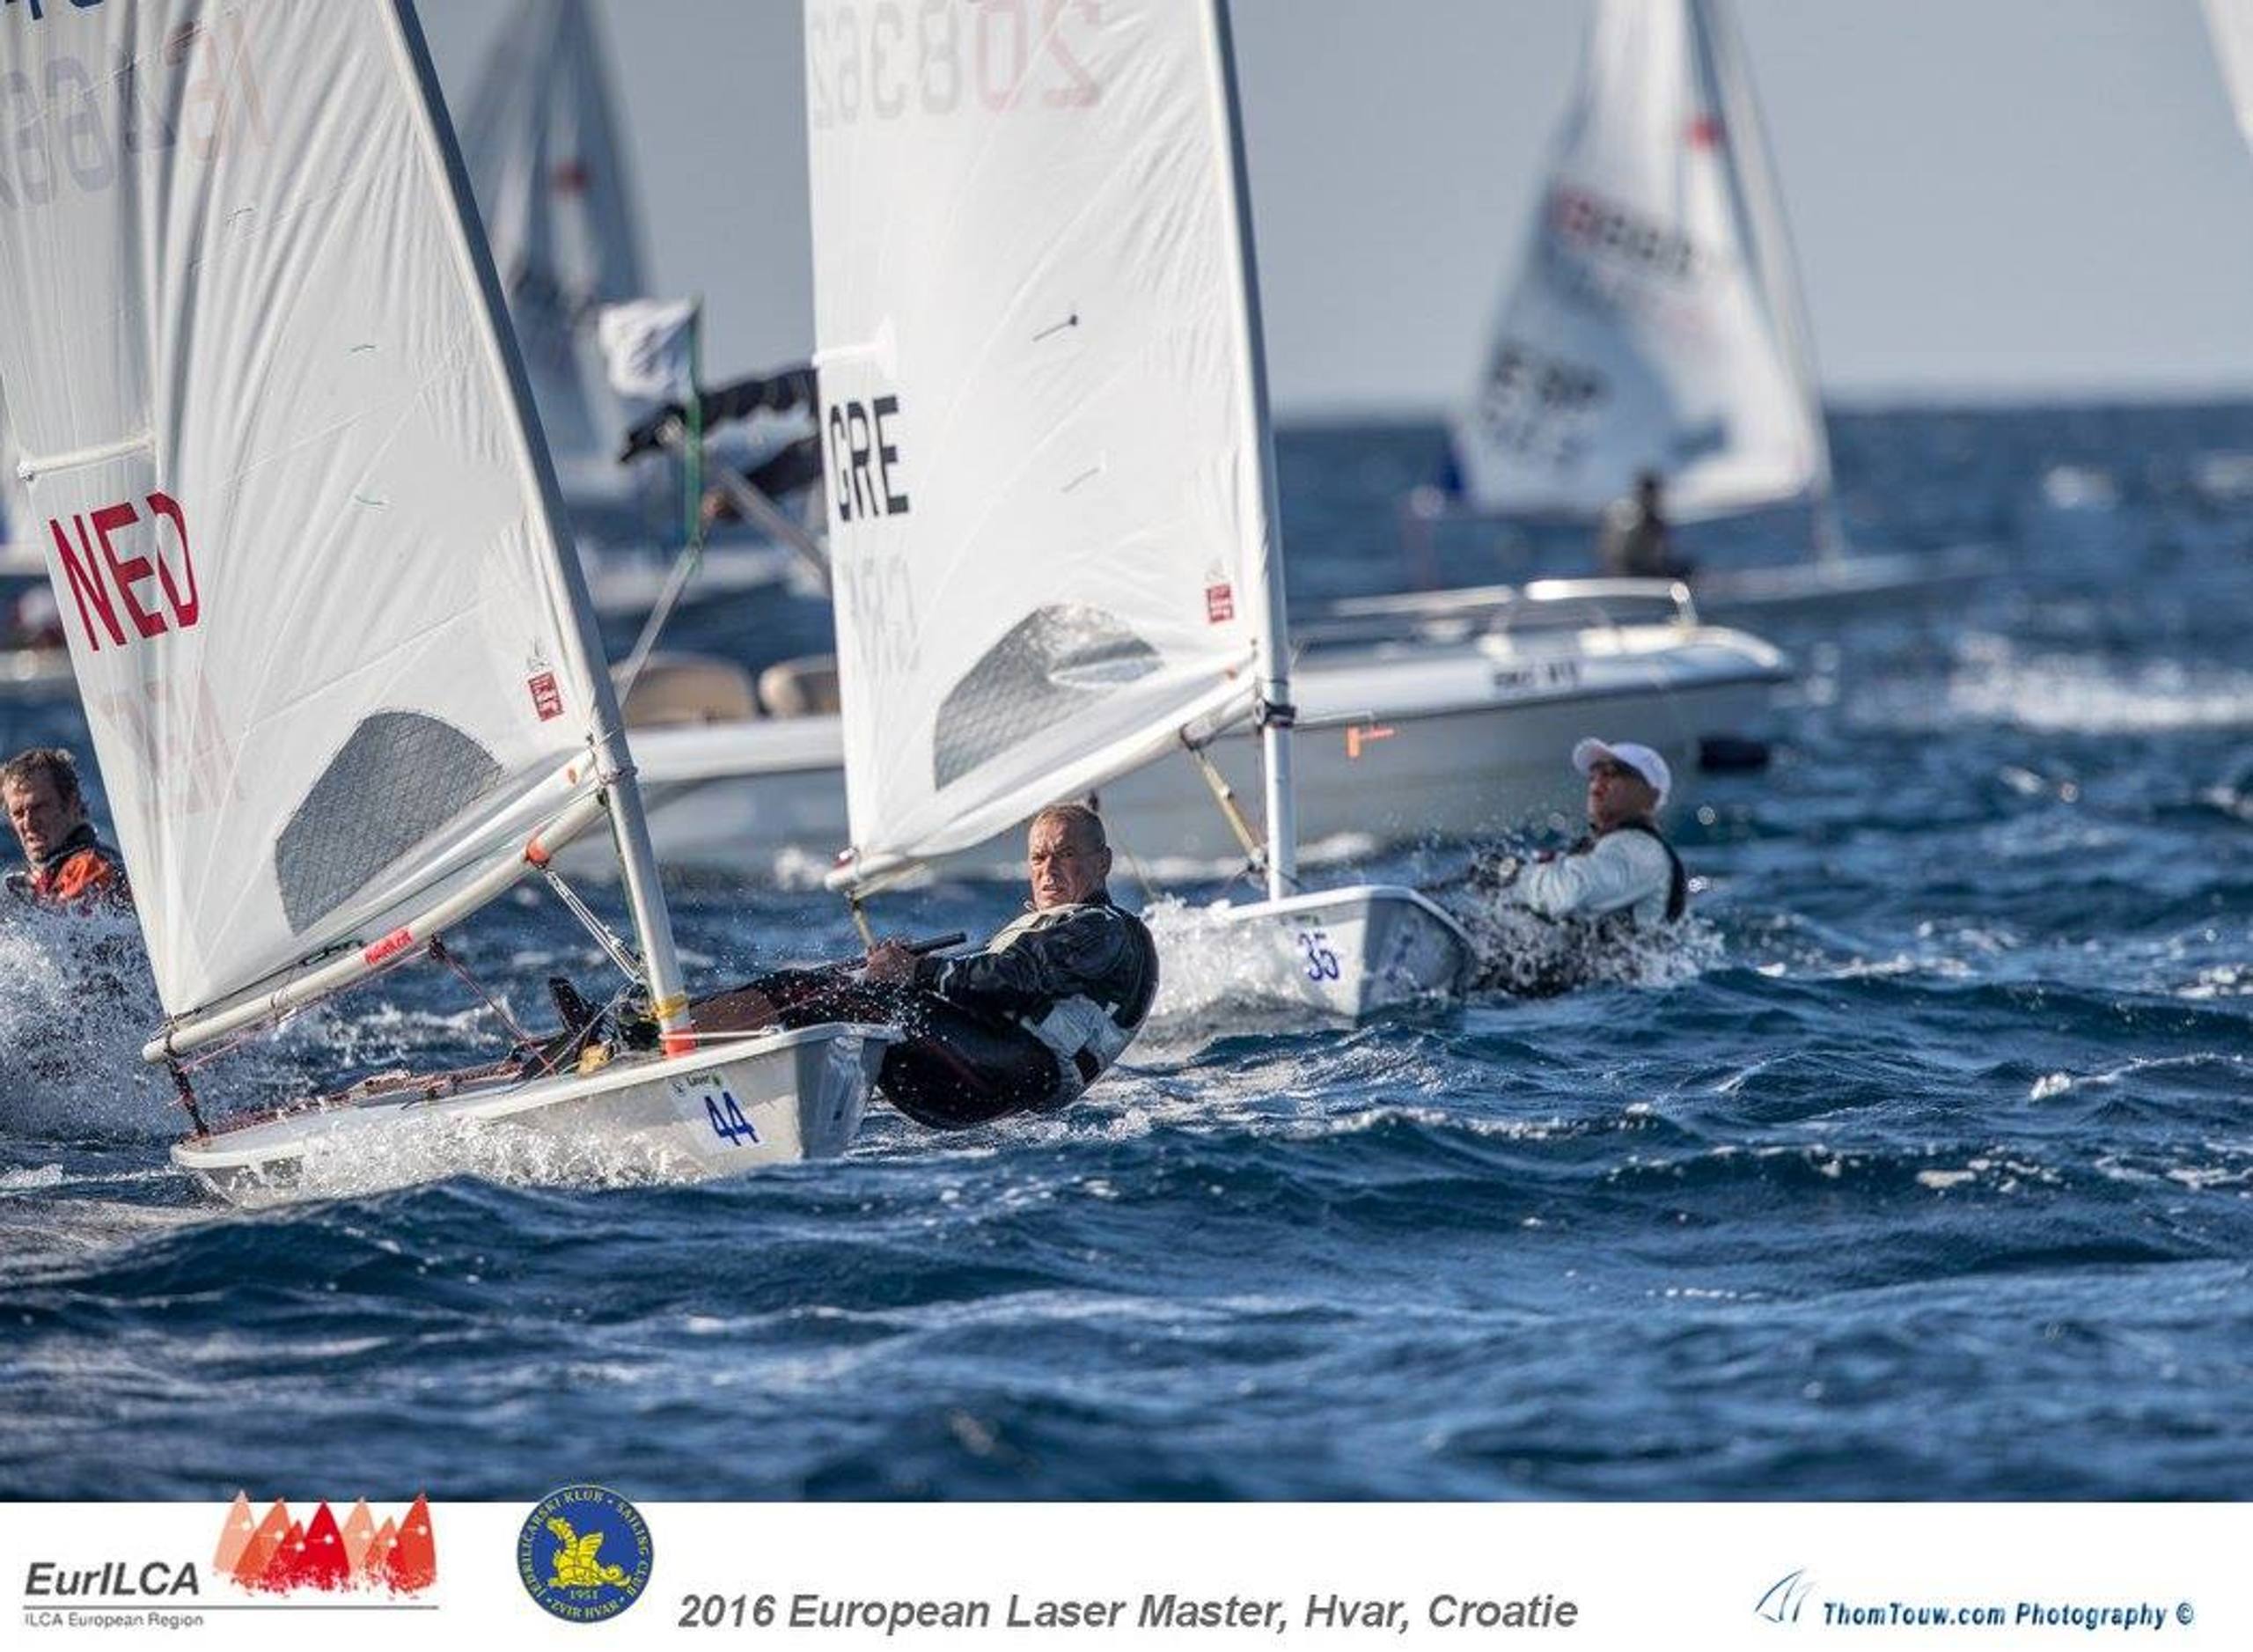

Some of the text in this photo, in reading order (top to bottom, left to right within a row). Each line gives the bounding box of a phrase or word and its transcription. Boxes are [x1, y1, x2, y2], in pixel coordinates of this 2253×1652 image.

[830, 394, 909, 522] GRE
[49, 488, 199, 651] NED
[1298, 933, 1339, 980] 35
[704, 1091, 760, 1146] 44
